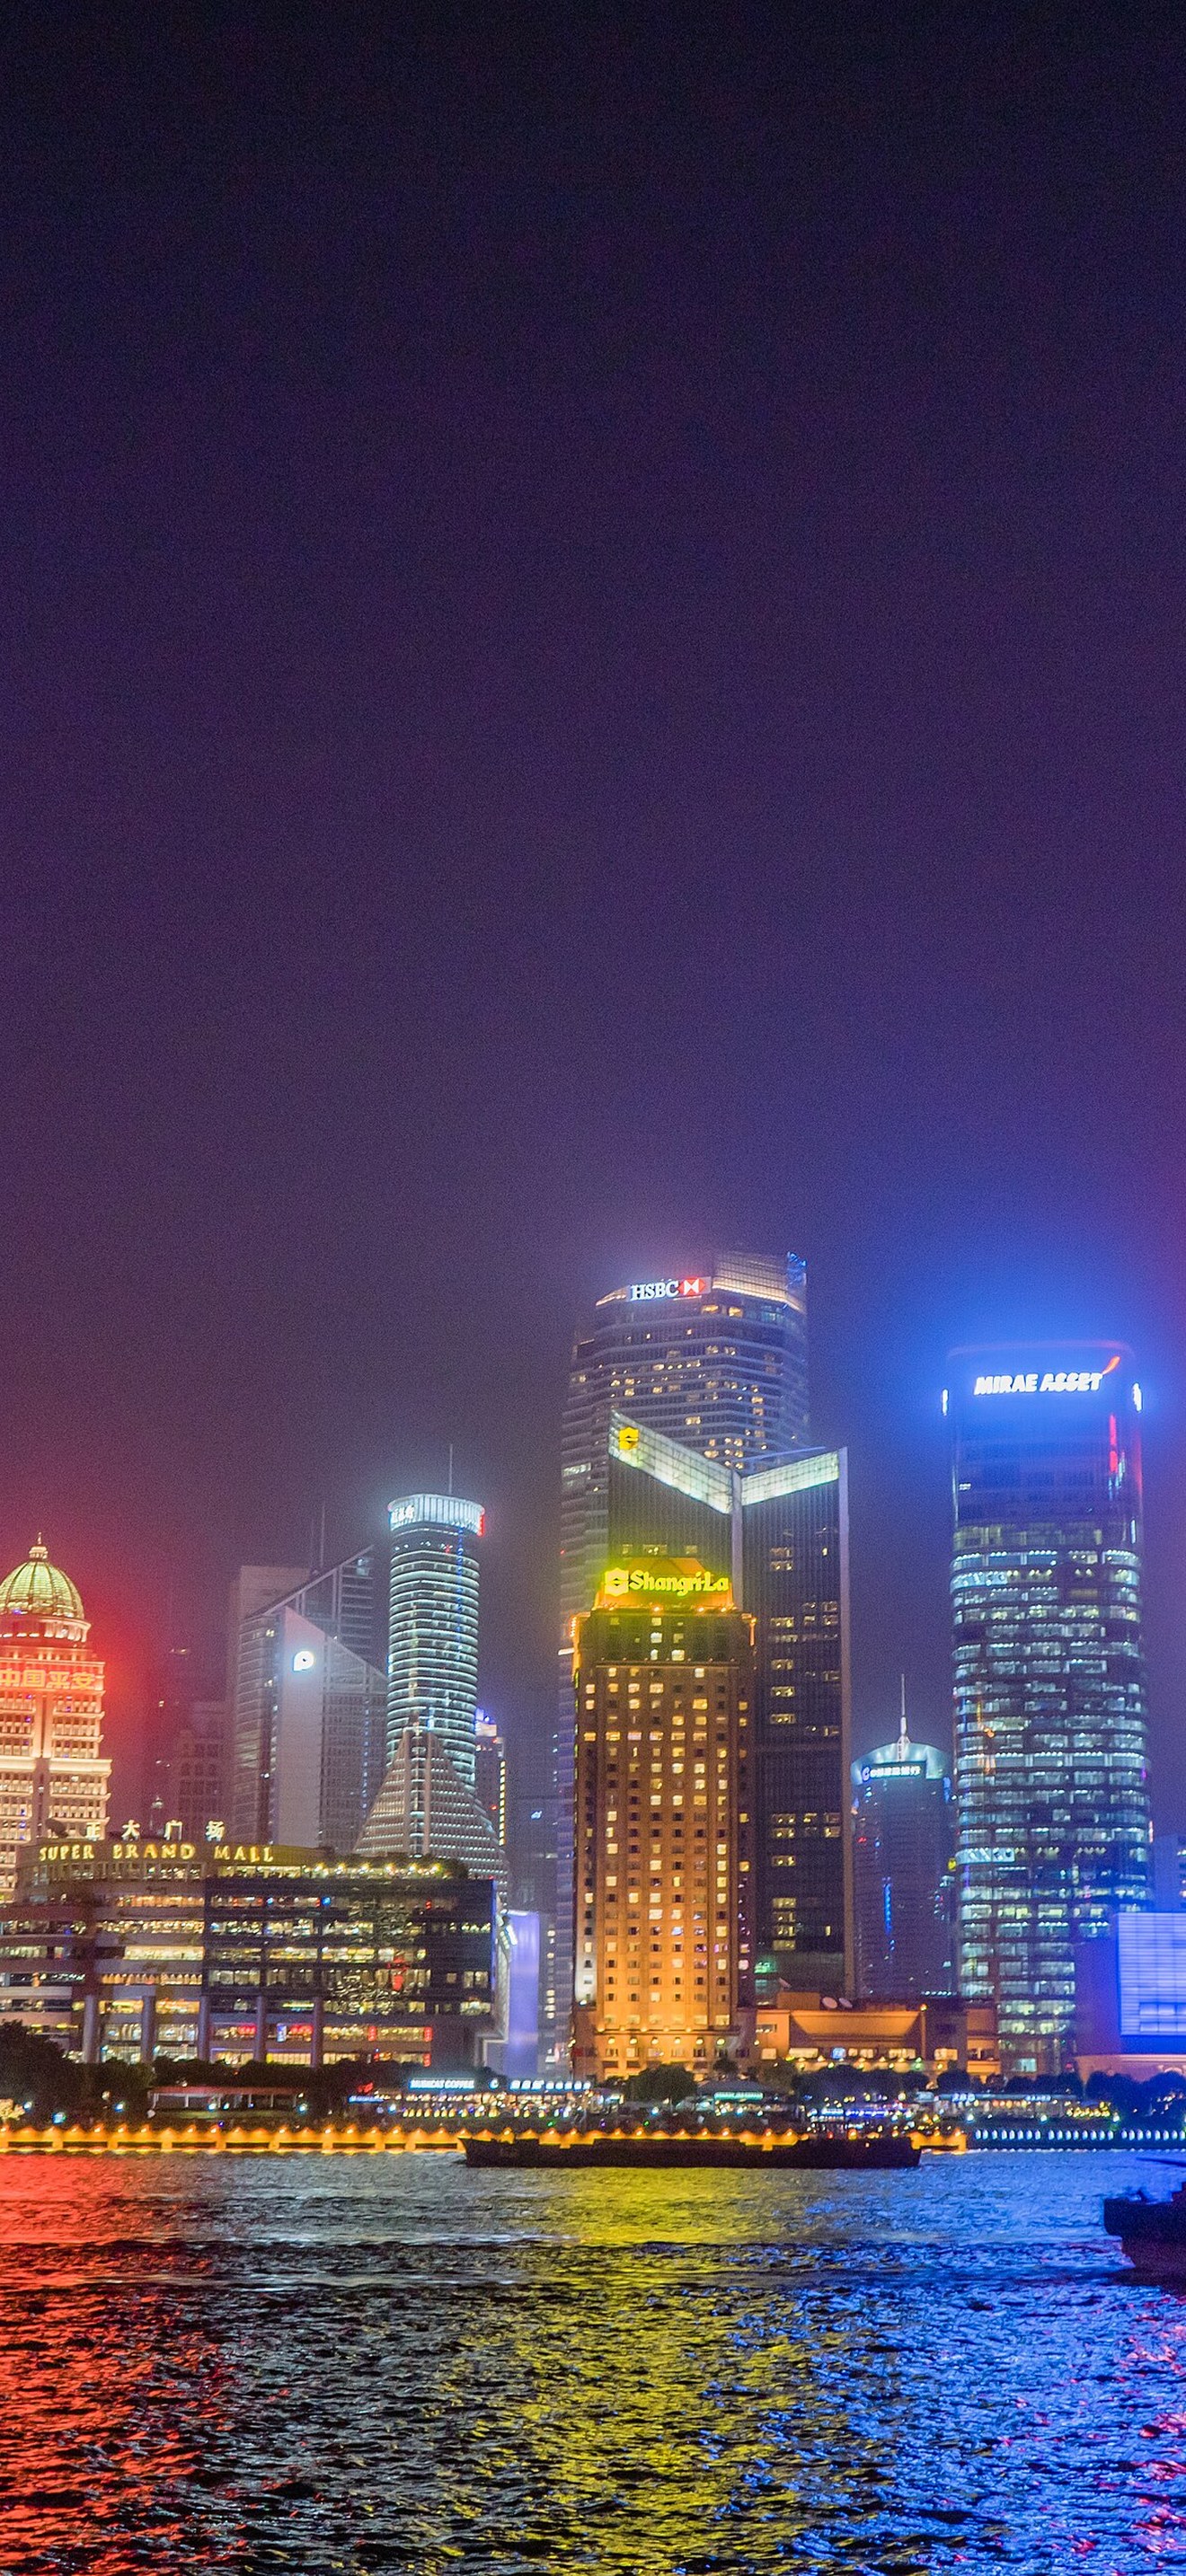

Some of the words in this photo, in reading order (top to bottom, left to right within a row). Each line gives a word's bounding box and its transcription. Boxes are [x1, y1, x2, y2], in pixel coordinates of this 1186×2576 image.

[630, 1280, 680, 1301] HSBC
[974, 1373, 1039, 1396] MIRAE
[1040, 1372, 1103, 1392] ASSET
[629, 1569, 730, 1596] Shangri-La
[0, 1668, 96, 1689] 中国平安
[85, 1820, 225, 1840] 正大广场
[39, 1844, 94, 1862] SUPER
[112, 1843, 196, 1860] BRAND
[213, 1844, 274, 1863] MALL
